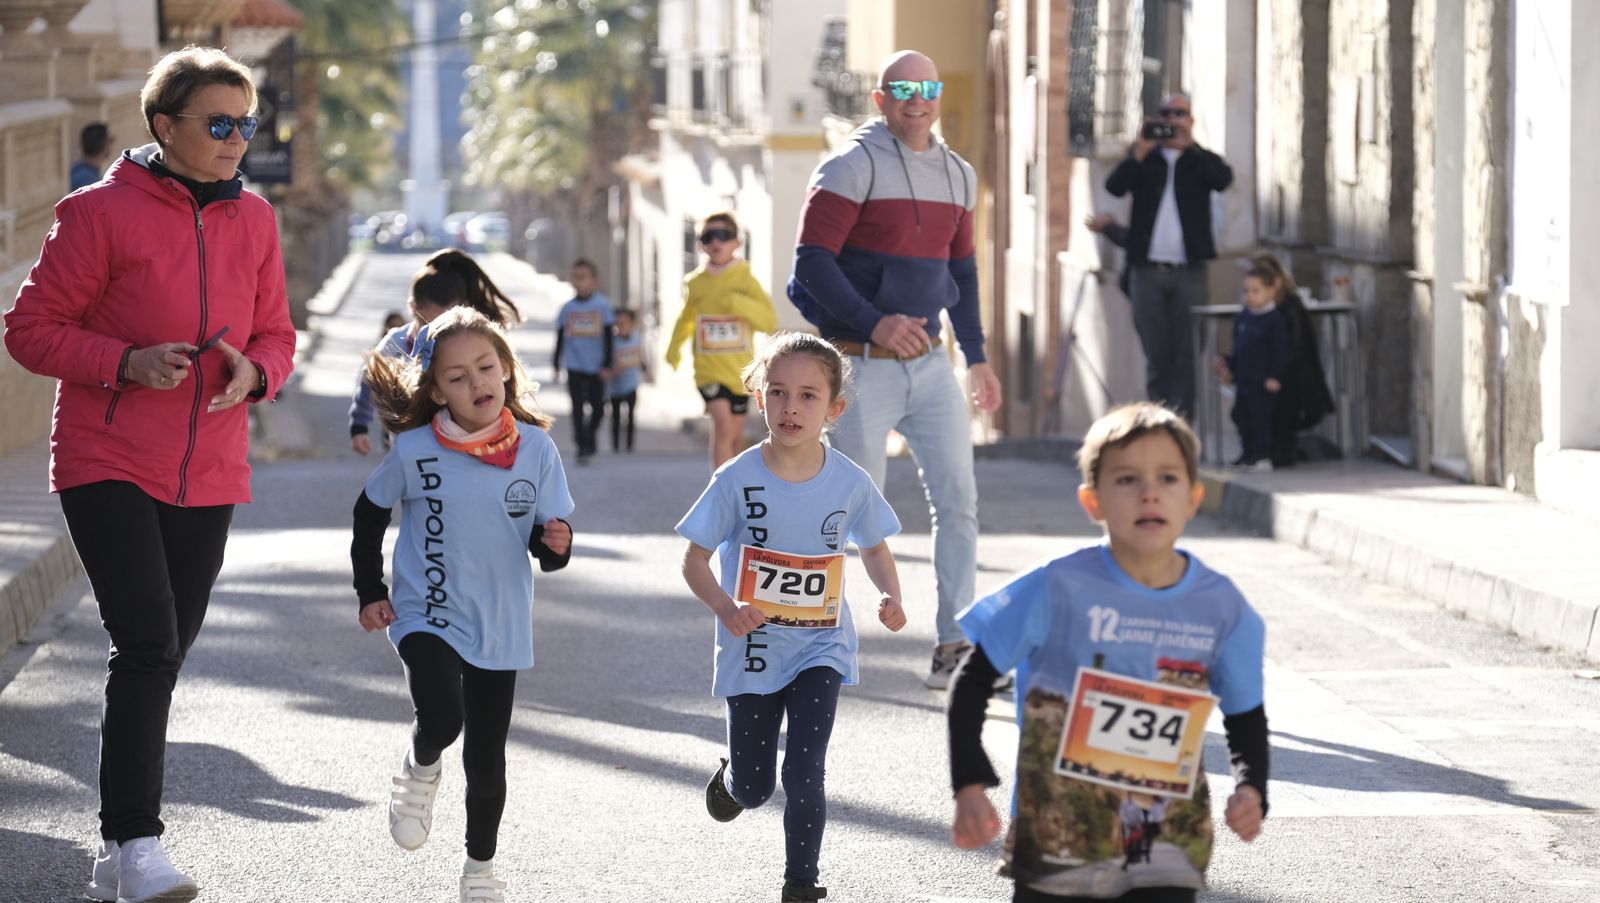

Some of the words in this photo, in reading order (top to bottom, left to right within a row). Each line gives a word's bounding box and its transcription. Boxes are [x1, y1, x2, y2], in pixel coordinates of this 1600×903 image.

[416, 457, 442, 491] LA
[743, 486, 768, 519] LA
[762, 555, 791, 567] POLVORA
[758, 565, 826, 597] 720
[1087, 604, 1120, 643] 12
[1121, 615, 1162, 629] CARRERA
[1163, 619, 1216, 635] SOLIDARIA
[1117, 629, 1155, 645] JAIME
[1155, 631, 1216, 650] JIMÉNEZ
[1100, 700, 1185, 747] 734
